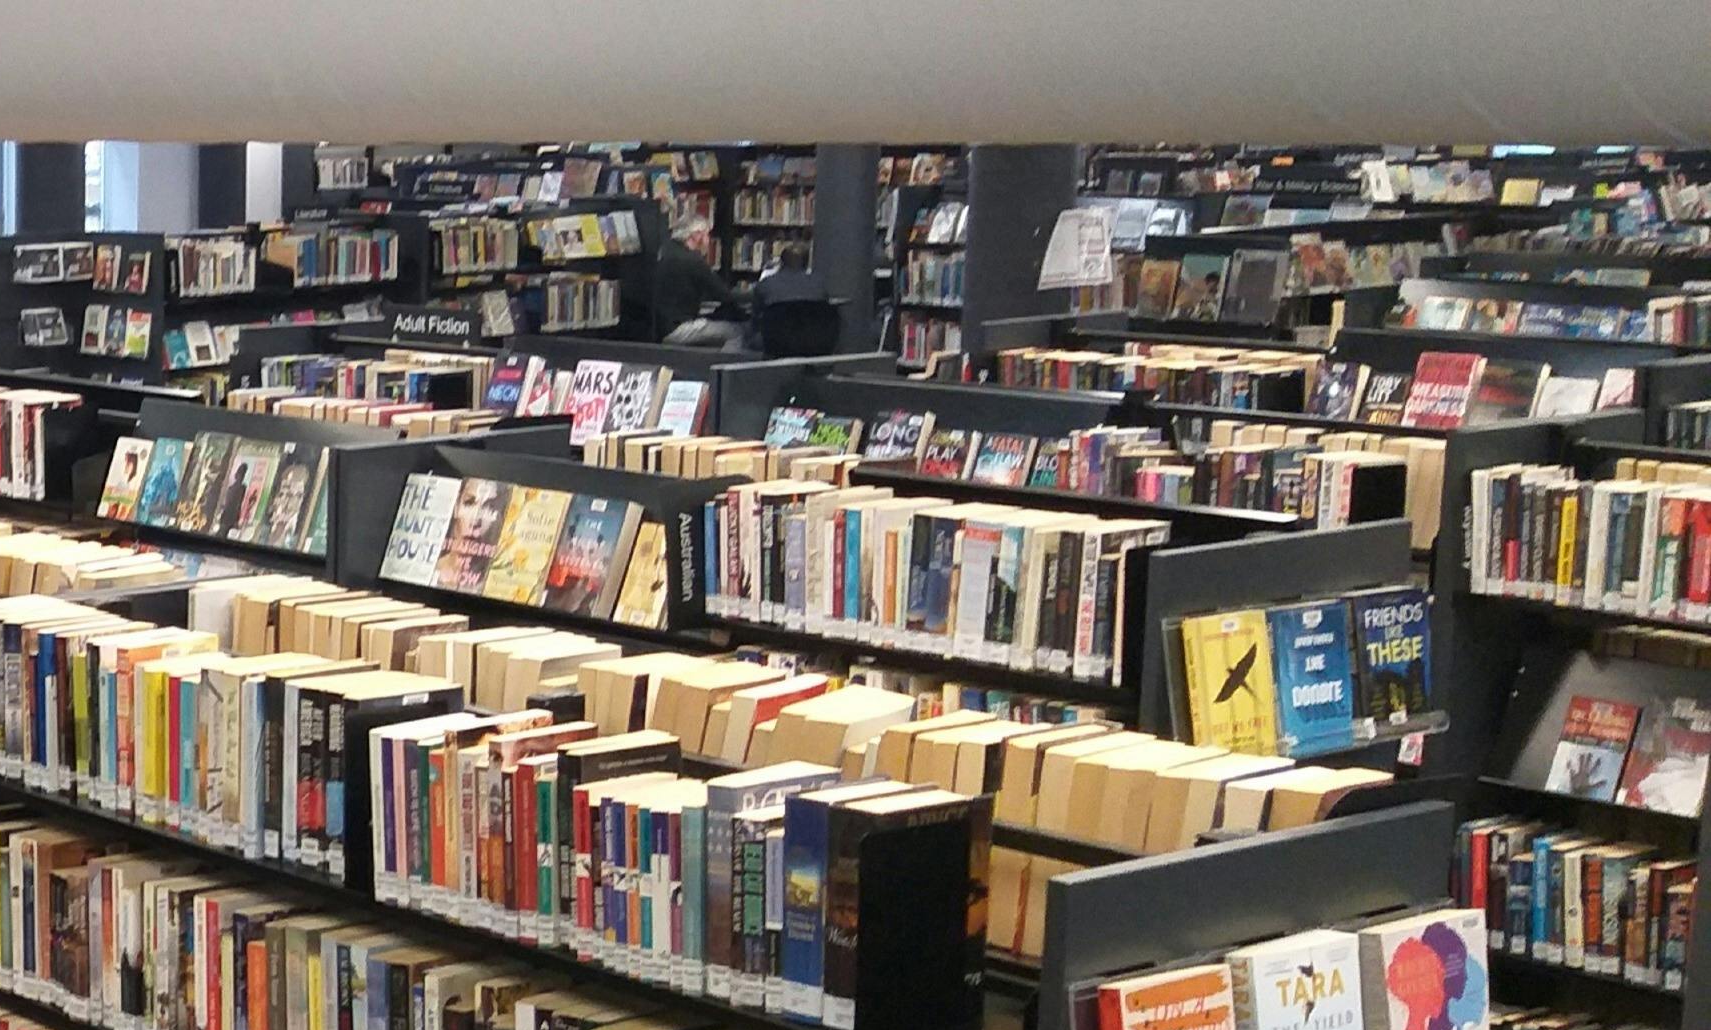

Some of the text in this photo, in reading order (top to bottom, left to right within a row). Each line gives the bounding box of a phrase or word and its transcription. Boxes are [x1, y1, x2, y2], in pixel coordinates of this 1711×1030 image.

[393, 312, 471, 336] Adult Fiction
[573, 371, 614, 396] MARS
[869, 422, 919, 443] LONG
[926, 445, 958, 461] PLAY
[402, 482, 436, 511] THE
[678, 512, 694, 602] Australian
[1363, 601, 1424, 629] FRIENDS
[1365, 635, 1424, 667] THESE
[1275, 967, 1345, 1009] TARA
[1314, 1009, 1354, 1030] YIELD
